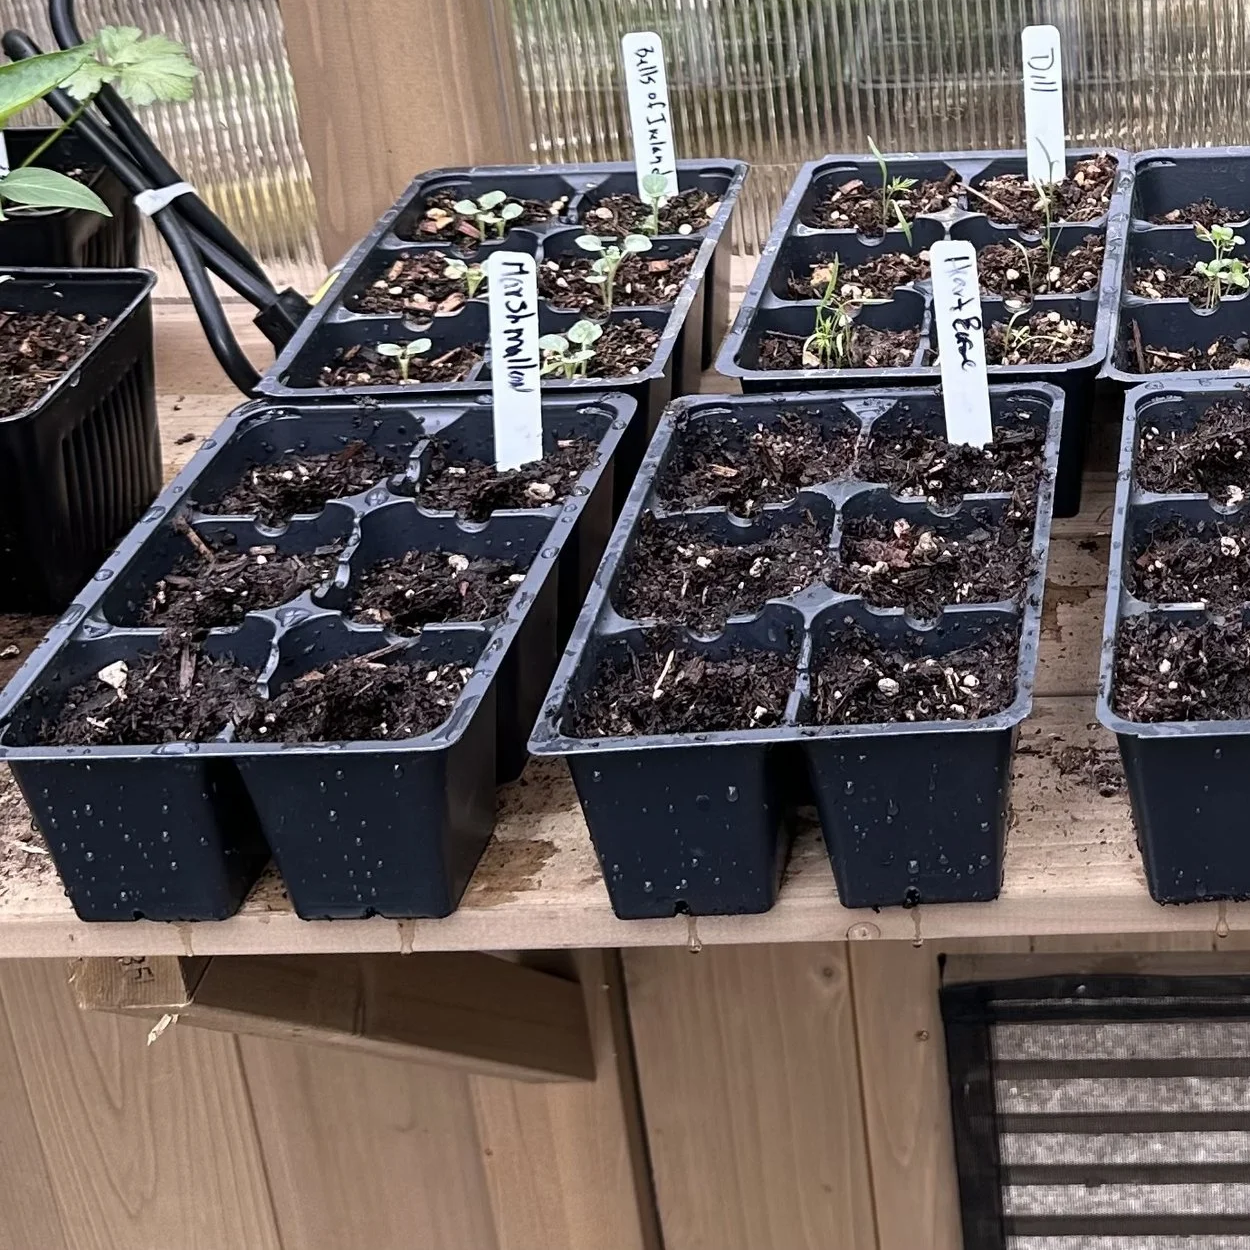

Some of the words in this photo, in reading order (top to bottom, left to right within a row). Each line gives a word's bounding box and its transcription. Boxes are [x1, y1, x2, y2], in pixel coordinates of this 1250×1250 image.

[634, 46, 659, 85] Bells
[1027, 47, 1058, 92] Dill
[647, 92, 666, 108] of
[646, 113, 674, 175] Ireland
